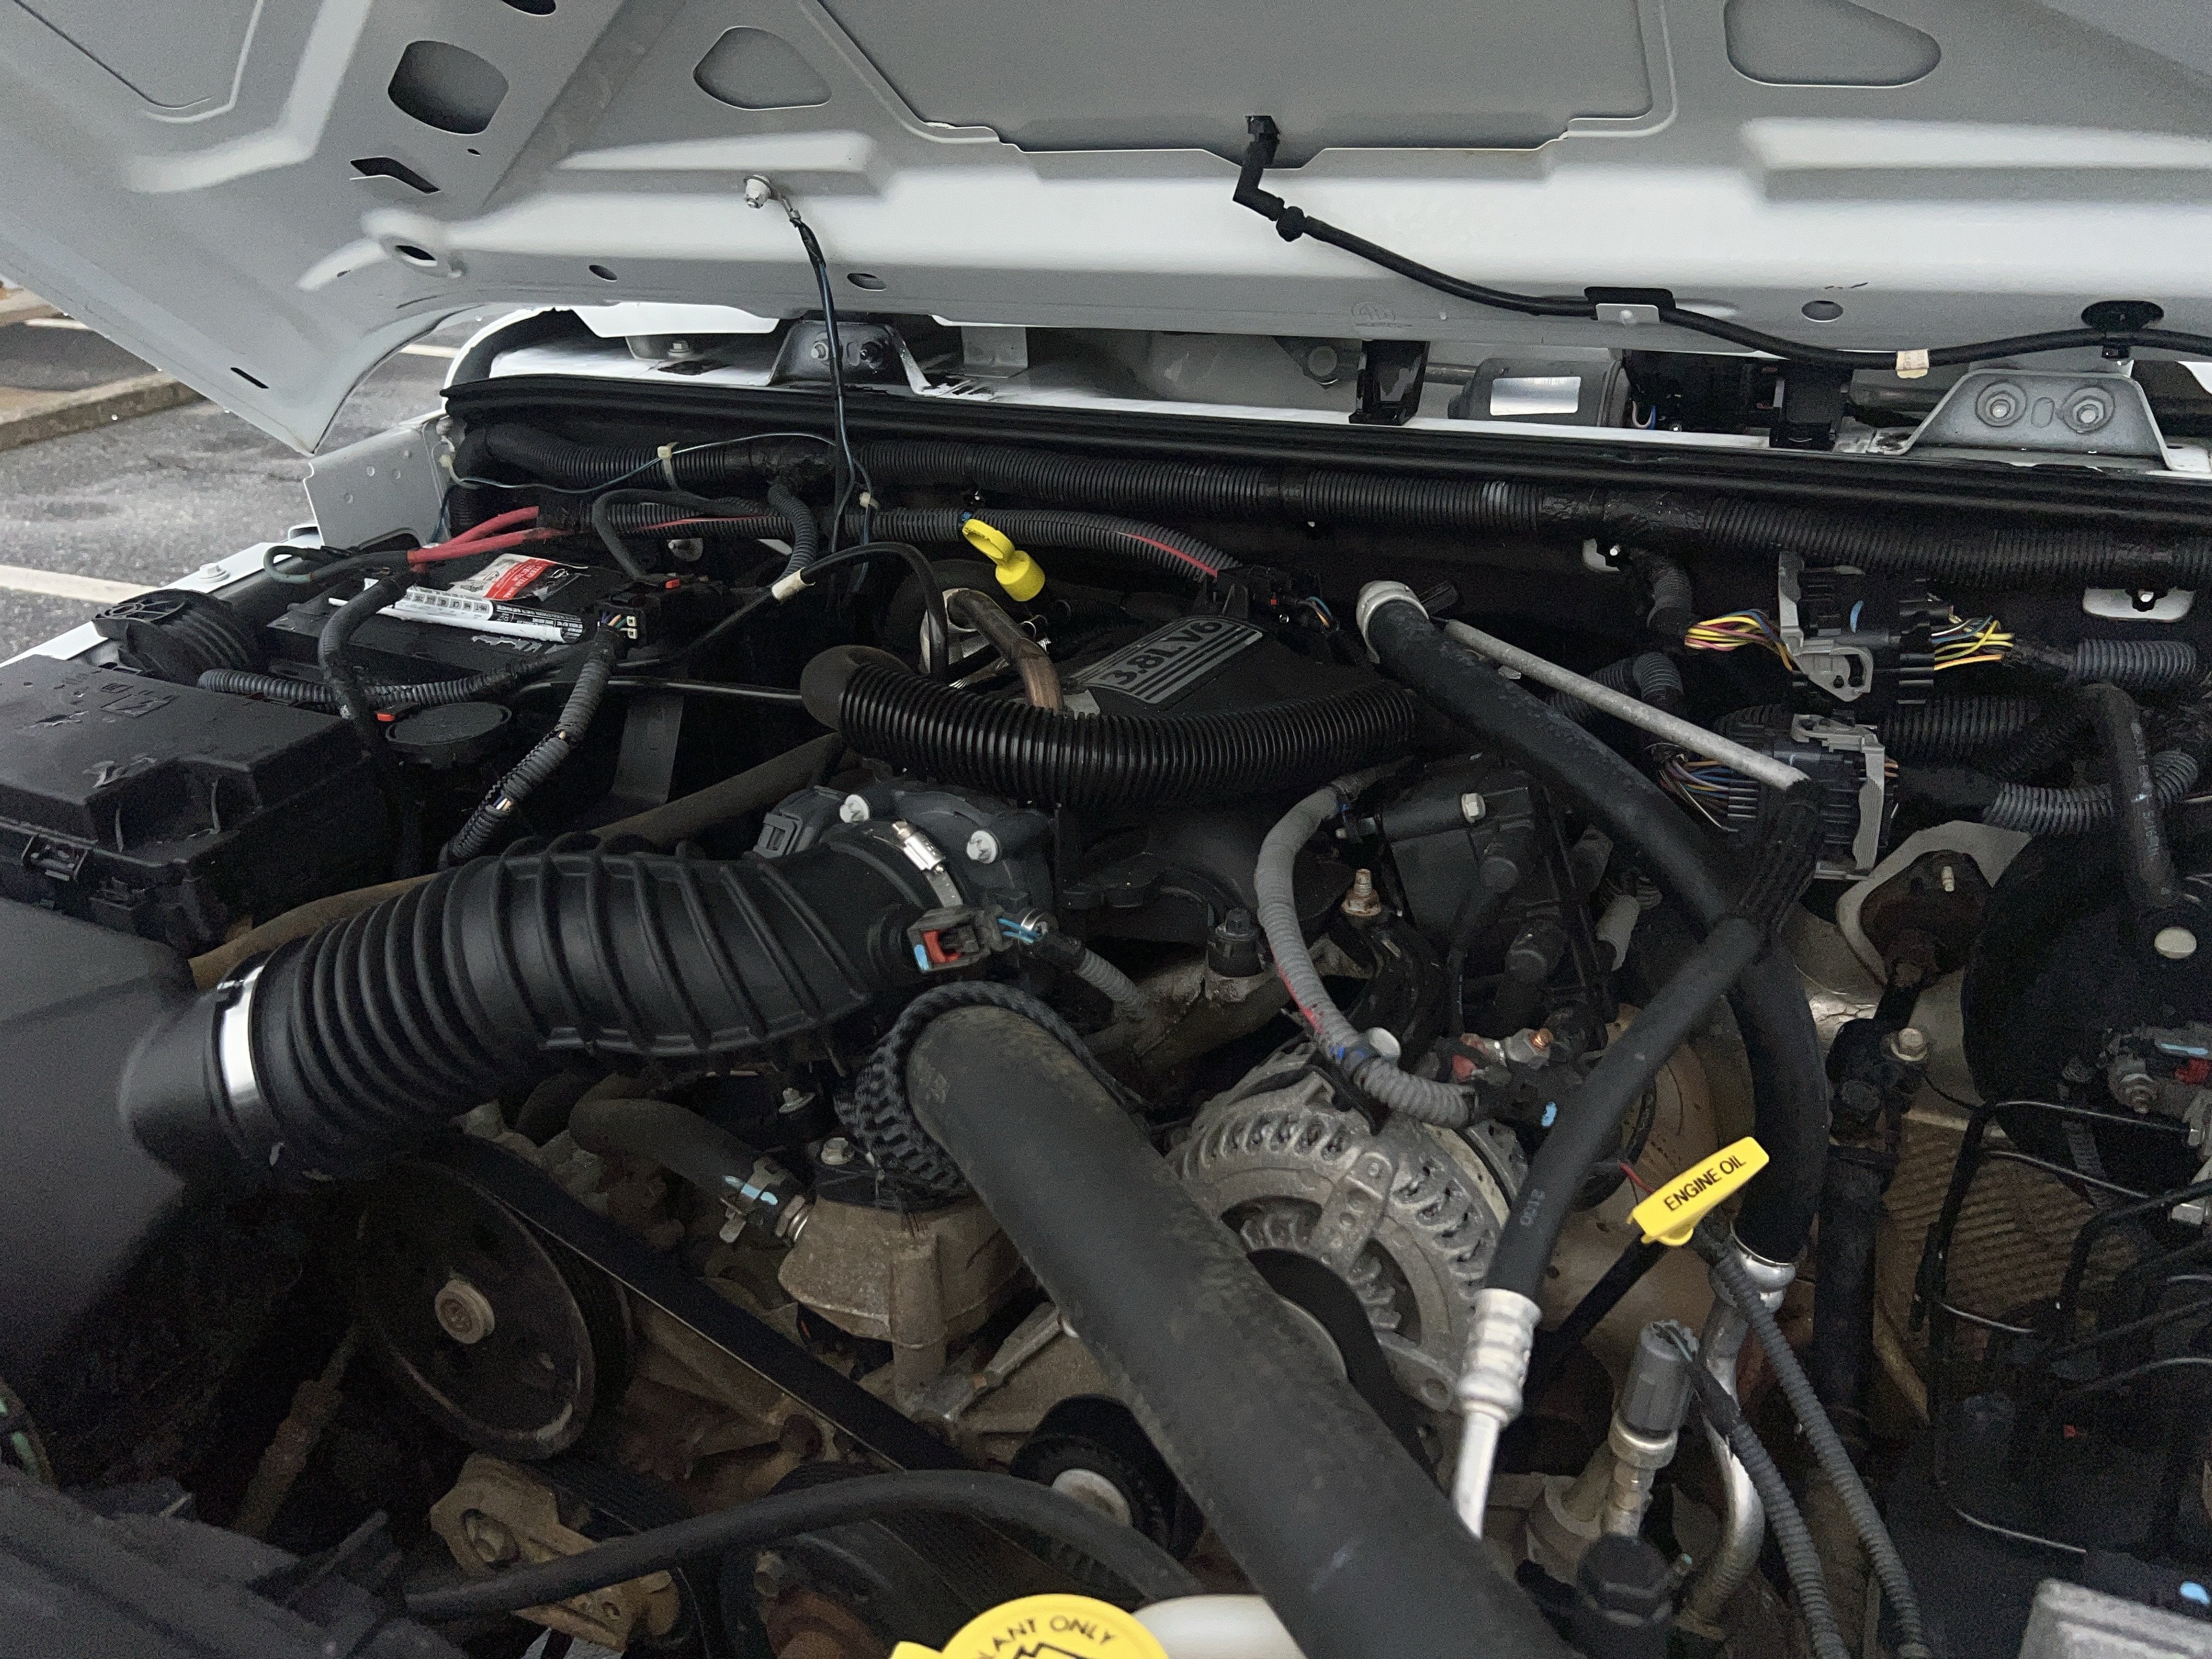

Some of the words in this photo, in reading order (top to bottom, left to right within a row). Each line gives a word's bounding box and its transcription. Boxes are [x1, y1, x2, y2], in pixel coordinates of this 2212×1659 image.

[1664, 1168, 1722, 1211] ENGINE
[1719, 1155, 1747, 1175] OIL
[1049, 1616, 1115, 1645] ONLY
